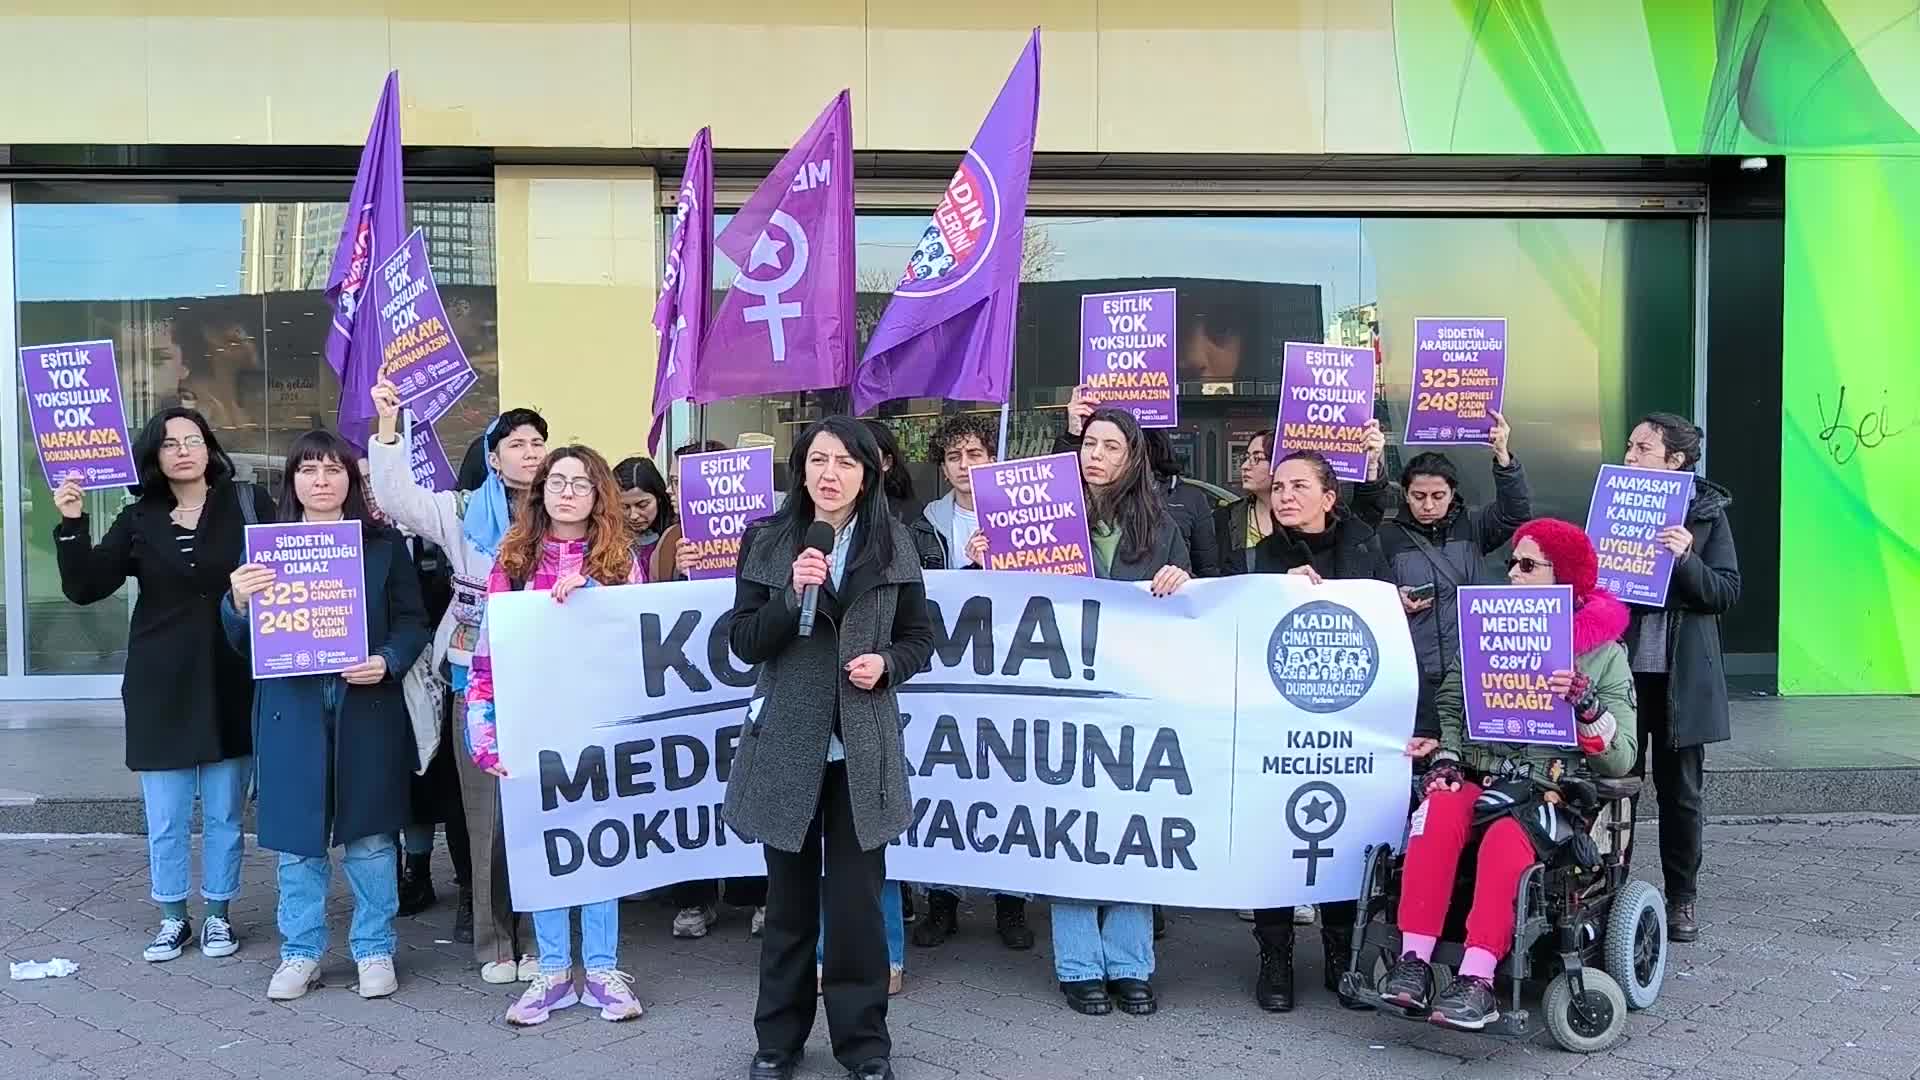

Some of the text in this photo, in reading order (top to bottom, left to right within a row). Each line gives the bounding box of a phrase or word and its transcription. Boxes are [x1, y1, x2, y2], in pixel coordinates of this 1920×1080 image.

[949, 170, 988, 231] ADIN
[388, 264, 412, 297] YOK
[381, 277, 428, 322] YOKSULLUK
[1103, 296, 1152, 314] EŞİTLİK
[392, 302, 420, 336] ÇOK
[1108, 314, 1148, 333] YOK
[384, 316, 444, 362] NAFAKAYA
[1089, 334, 1167, 350] YOKSULLUK
[1438, 327, 1484, 339] ŞİDDETİN
[1420, 338, 1502, 350] ARABULUCULUĞU
[40, 348, 92, 369] EŞİTLİK
[1107, 350, 1147, 371] ÇOK
[1306, 350, 1354, 367] EŞİTLİK
[1442, 351, 1479, 362] OLMAZ
[48, 368, 89, 389] YOK
[1086, 372, 1169, 388] NAFAKAYA
[1311, 367, 1349, 387] YOK
[1420, 368, 1461, 388] 325
[1461, 368, 1488, 377] KADIN
[34, 388, 112, 408] YOKSULLUK
[1086, 390, 1170, 400] DOKUNAMAZSIN
[1290, 386, 1366, 404] YOKSULLUK
[1417, 392, 1458, 411] 248
[1458, 401, 1485, 409] KADIN
[54, 407, 95, 430] ÇOK
[1307, 403, 1346, 423] ÇOK
[40, 428, 121, 448] NAFAKAYA
[1284, 423, 1363, 441] NAFAKAYA
[44, 446, 125, 462] DOKUNAMAZSIN
[1282, 439, 1363, 454] DOKUNAMAZSIN
[701, 454, 751, 475] EŞİTLİK
[995, 462, 1055, 486] EŞİTLİK
[706, 473, 746, 496] YOK
[1004, 482, 1052, 507] YOK
[1606, 475, 1681, 495] ANAYASAYI
[688, 494, 767, 516] YOKSULLUK
[1612, 491, 1667, 509] MEDENİ
[986, 501, 1077, 528] YOKSULLUK
[1606, 506, 1666, 526] KANUNU
[708, 513, 747, 537] ÇOK
[275, 532, 335, 549] ŞİDDETİN
[1011, 522, 1058, 549] ÇOK
[253, 544, 357, 563] ARABULUCULUĞU
[690, 537, 741, 556] NAFAK
[991, 543, 1084, 570] NAFAKAYA
[1600, 537, 1663, 559] UYGULA-
[284, 561, 329, 575] OLMAZ
[1597, 554, 1655, 576] TACAĞIZ
[259, 580, 309, 606] 325
[310, 578, 343, 590] KADIN
[310, 588, 357, 600] CİNAYETİ
[1470, 598, 1561, 614] ANAYASAYI
[259, 608, 310, 634] 248
[311, 616, 345, 629] KADIN
[1292, 613, 1354, 630] KADIN
[1482, 614, 1548, 632] MEDENİ
[1282, 629, 1363, 647] CİNAYETLERİNİ
[1480, 636, 1551, 651] KANUNU
[1481, 672, 1549, 690] UYGULA
[1482, 690, 1553, 711] TACAĞIZ
[1288, 731, 1353, 748] KADIN
[901, 713, 1192, 795] ANUNA
[1262, 752, 1374, 775] MECLİSLERİ
